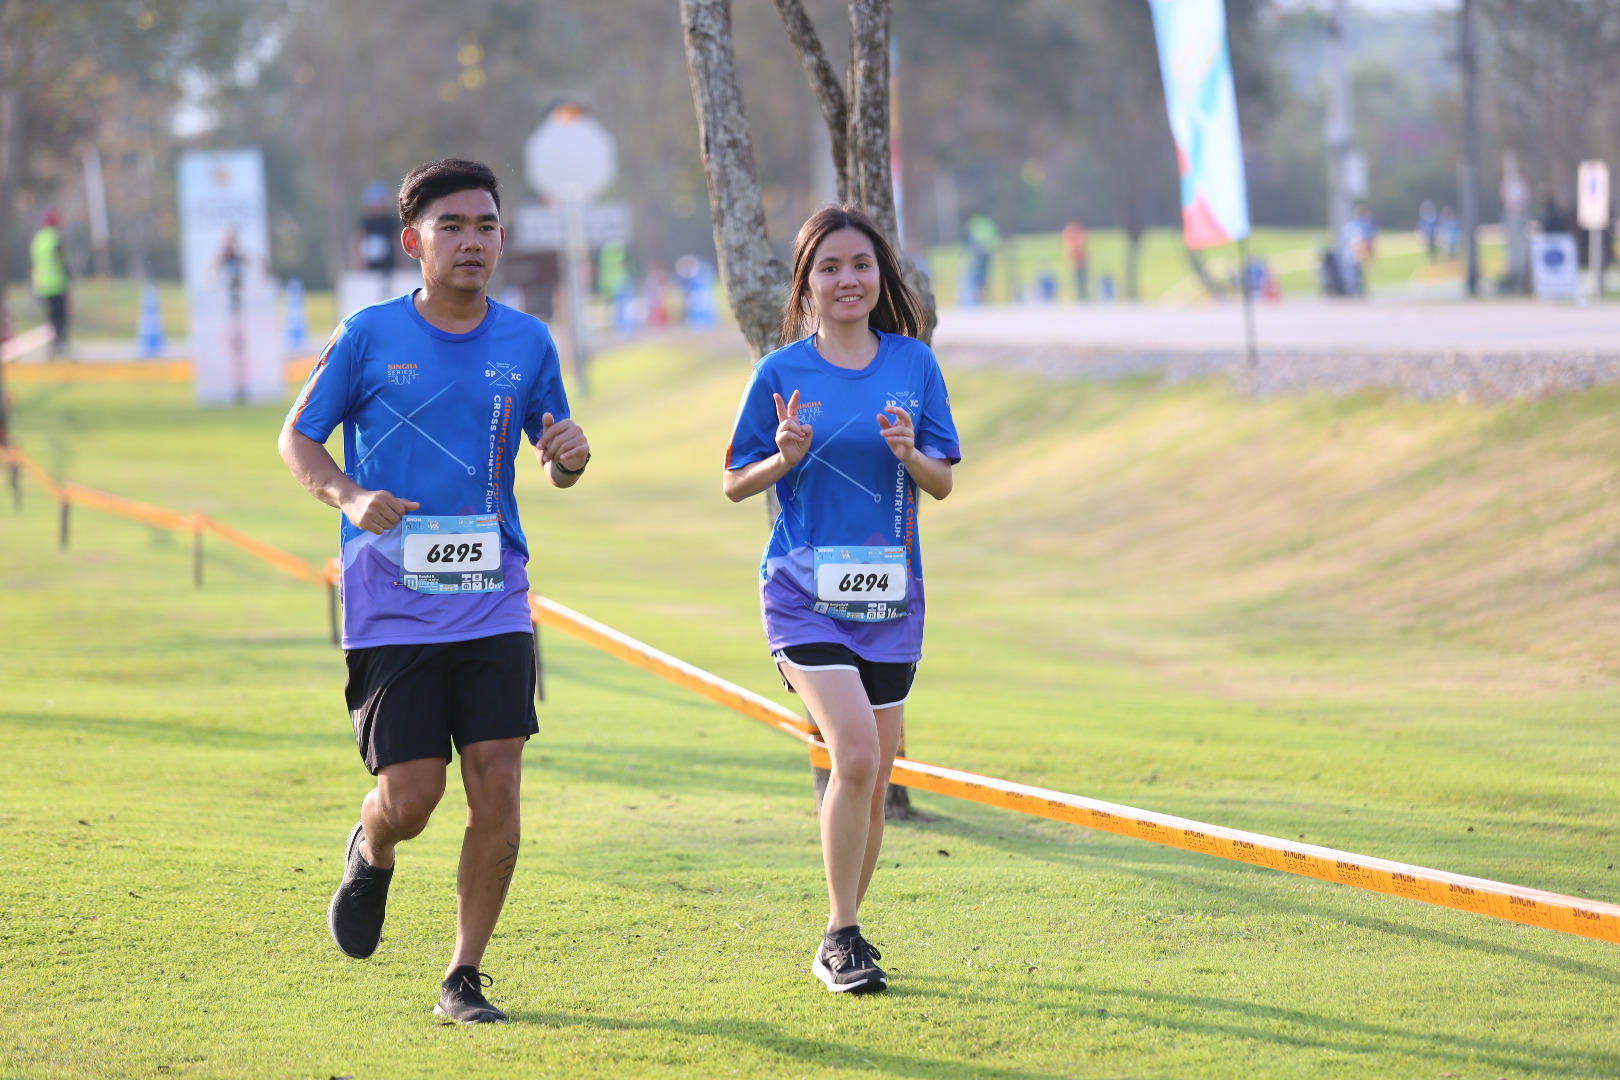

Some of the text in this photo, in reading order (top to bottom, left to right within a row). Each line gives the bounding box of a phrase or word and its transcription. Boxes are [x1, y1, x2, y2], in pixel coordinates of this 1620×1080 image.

[484, 369, 522, 381] SP XC
[909, 399, 919, 408] XC
[490, 394, 501, 431] CROSS
[894, 462, 905, 513] COUNTRY
[485, 490, 494, 513] RUN
[894, 515, 902, 538] RUN
[426, 542, 483, 563] 6295
[483, 577, 495, 590] 16
[838, 573, 889, 592] 6294
[887, 607, 897, 619] 16
[1449, 883, 1475, 896] SINGHA
[1510, 895, 1537, 909] SINGHA
[1573, 907, 1601, 921] SINGHA
